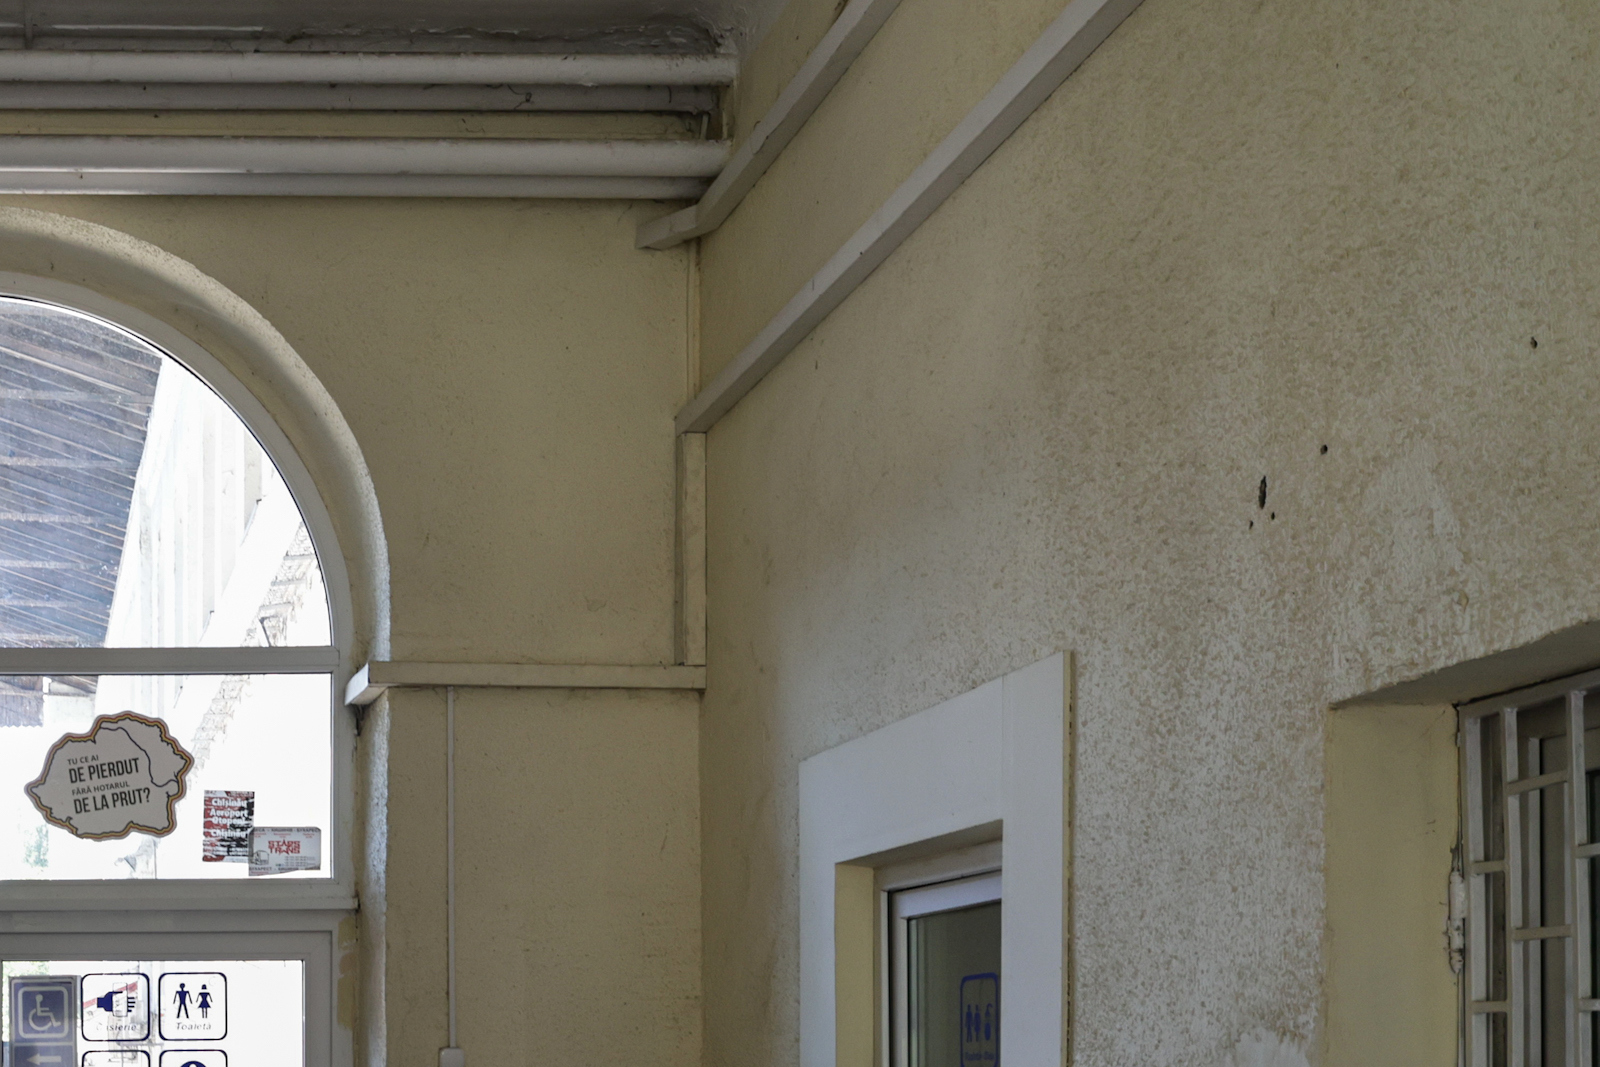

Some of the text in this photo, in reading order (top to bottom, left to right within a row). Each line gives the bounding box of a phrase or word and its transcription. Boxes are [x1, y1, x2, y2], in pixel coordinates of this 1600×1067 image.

[67, 754, 100, 766] TU CE AI
[68, 757, 140, 784] DE PIERDUT
[93, 780, 131, 793] HOTARUL
[73, 787, 151, 815] DE LA PRUT?
